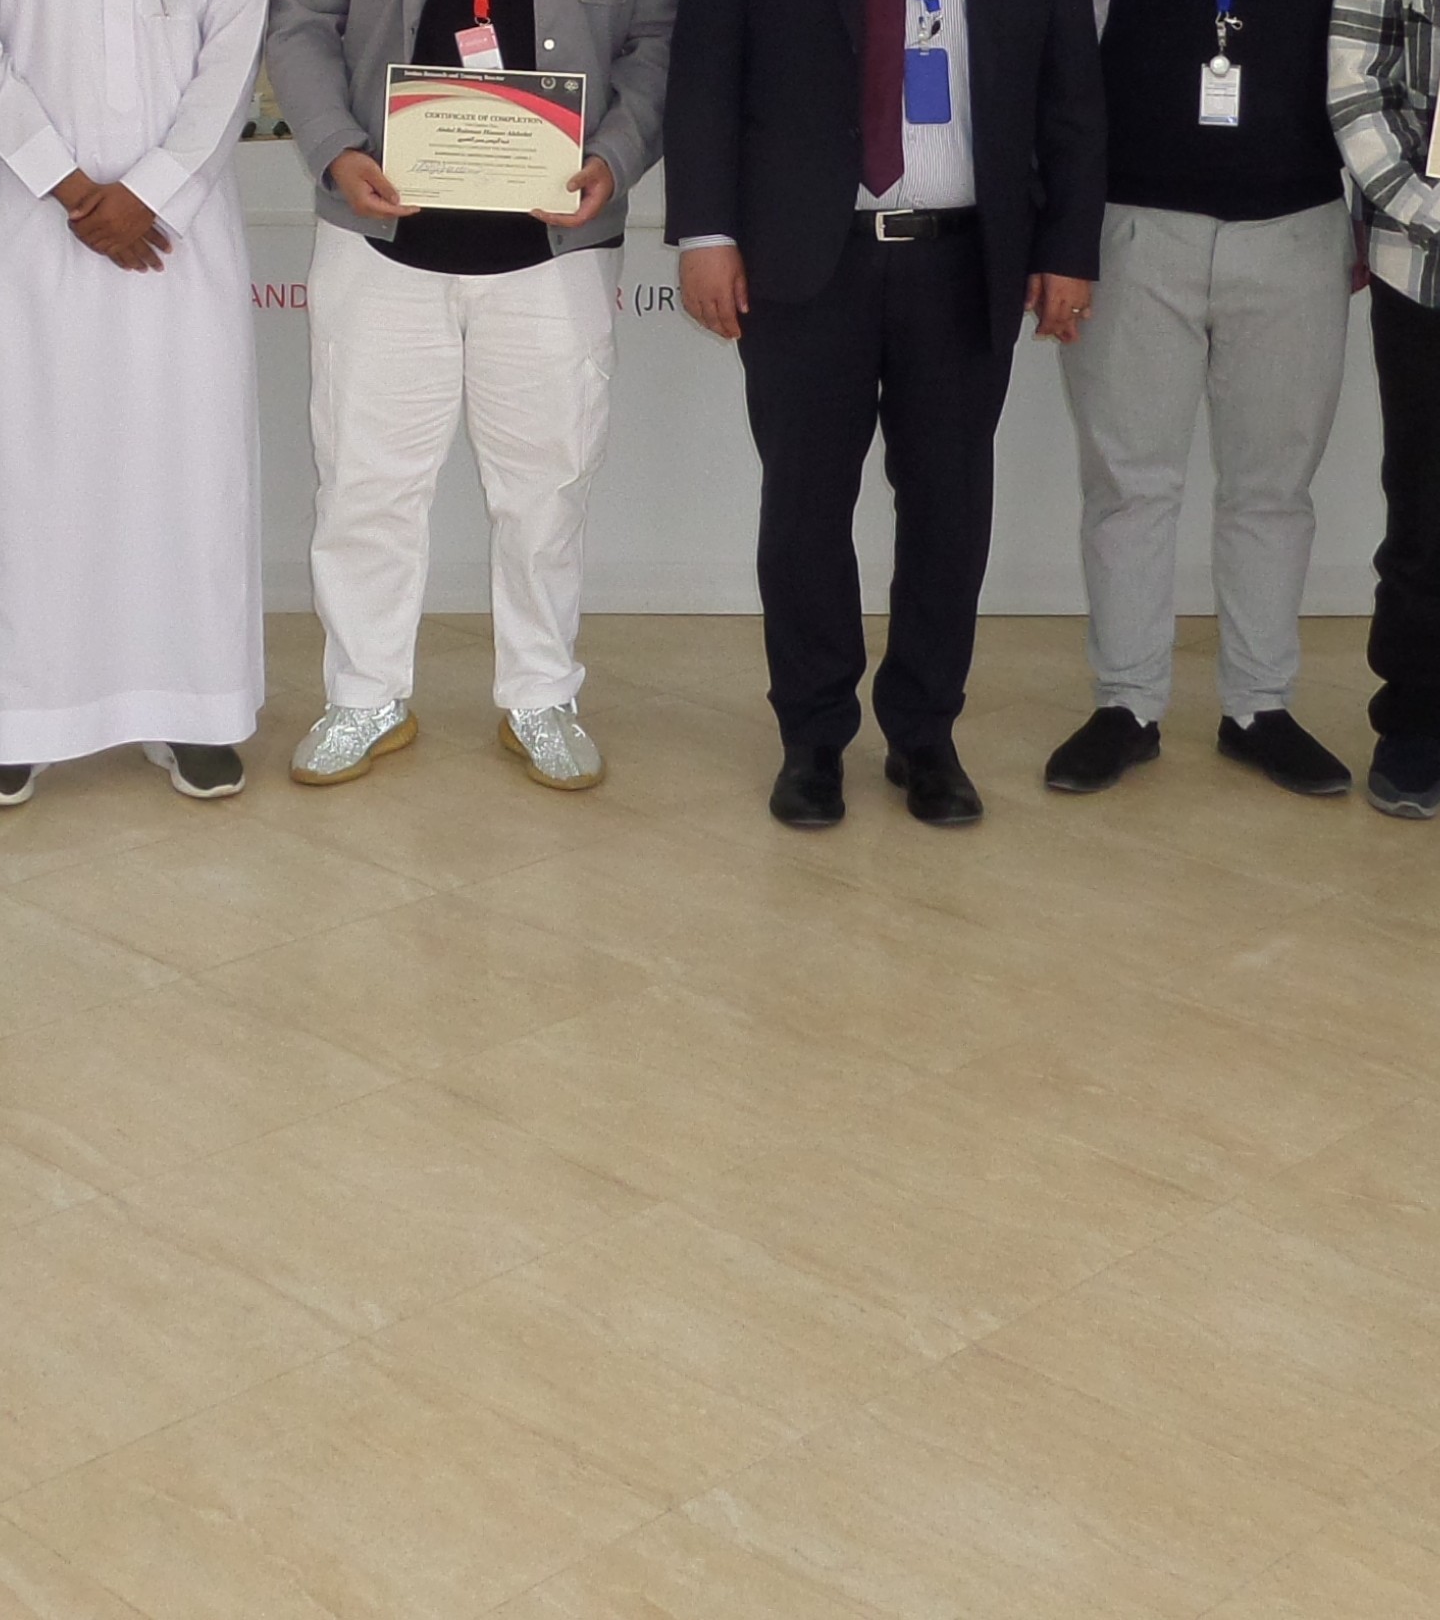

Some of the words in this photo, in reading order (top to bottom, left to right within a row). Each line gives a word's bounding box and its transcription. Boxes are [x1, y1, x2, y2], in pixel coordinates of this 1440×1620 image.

[425, 111, 475, 121] CERTIFICATE
[490, 115, 543, 124] COMPLETION
[250, 283, 308, 308] AND
[634, 284, 681, 317] (JR
